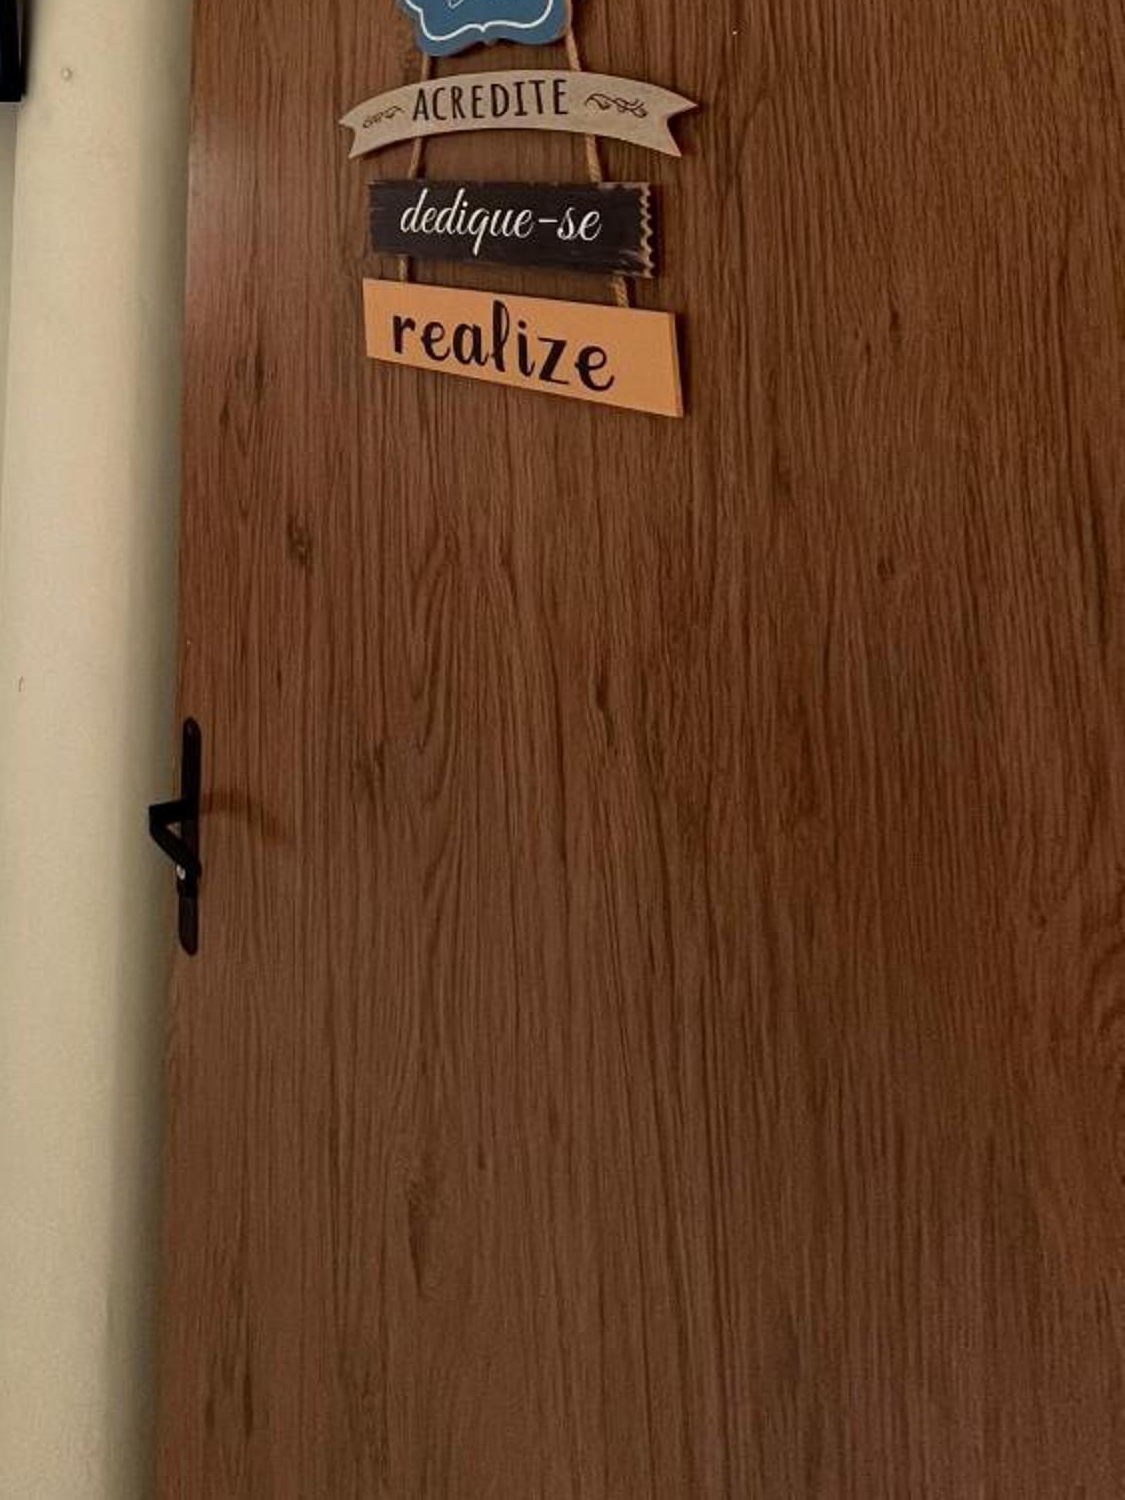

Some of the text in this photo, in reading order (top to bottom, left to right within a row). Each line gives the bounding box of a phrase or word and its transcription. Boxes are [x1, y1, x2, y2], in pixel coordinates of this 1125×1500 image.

[412, 79, 569, 121] ACREDITE
[400, 187, 602, 256] dedique-se
[392, 299, 615, 392] realize
